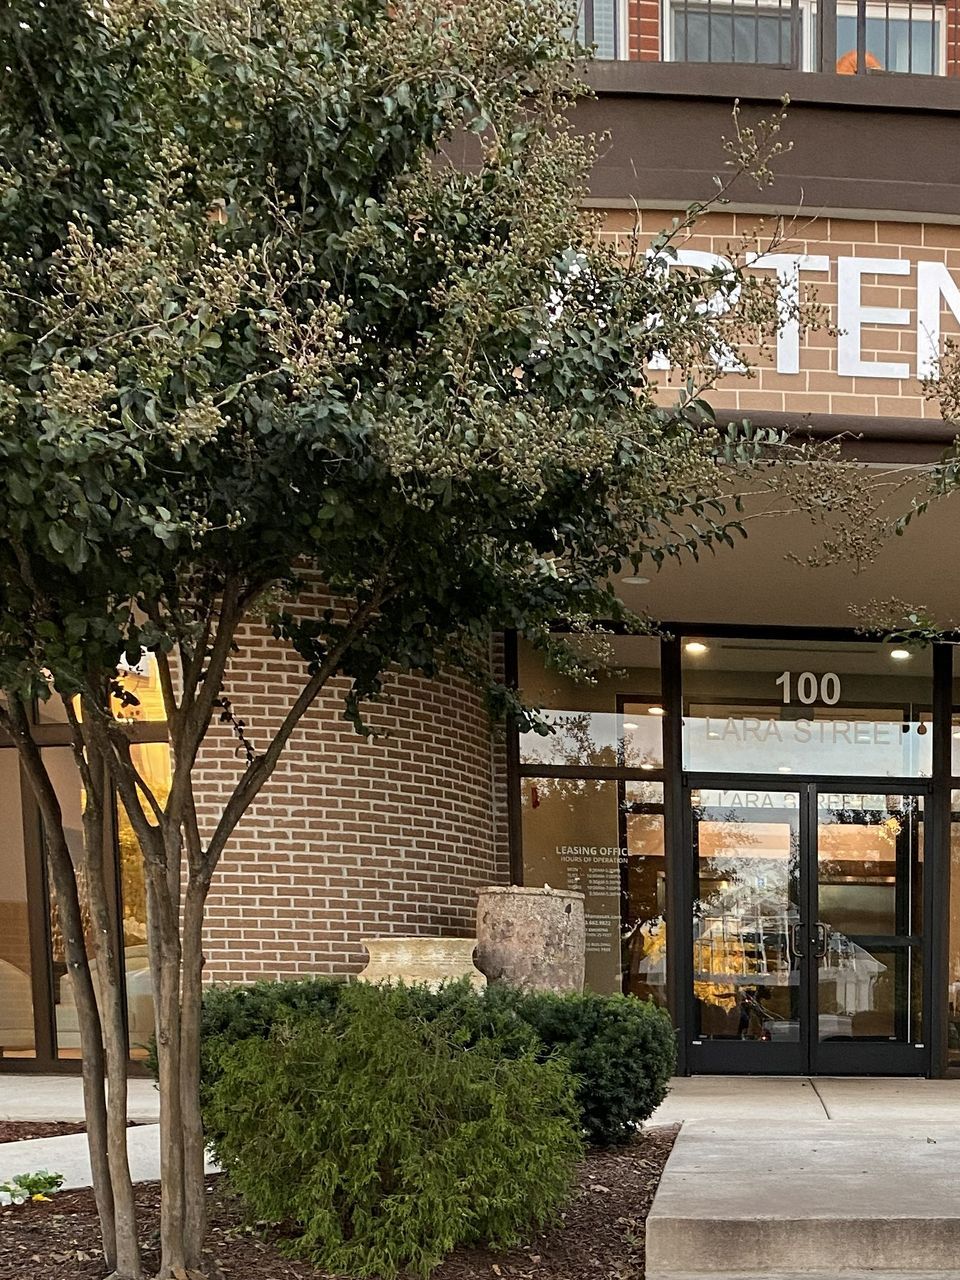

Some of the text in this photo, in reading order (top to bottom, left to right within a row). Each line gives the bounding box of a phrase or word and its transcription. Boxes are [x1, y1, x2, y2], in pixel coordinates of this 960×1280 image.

[775, 671, 841, 706] 100
[705, 716, 909, 745] LARA STREET
[555, 846, 633, 856] LEASING OFFICE
